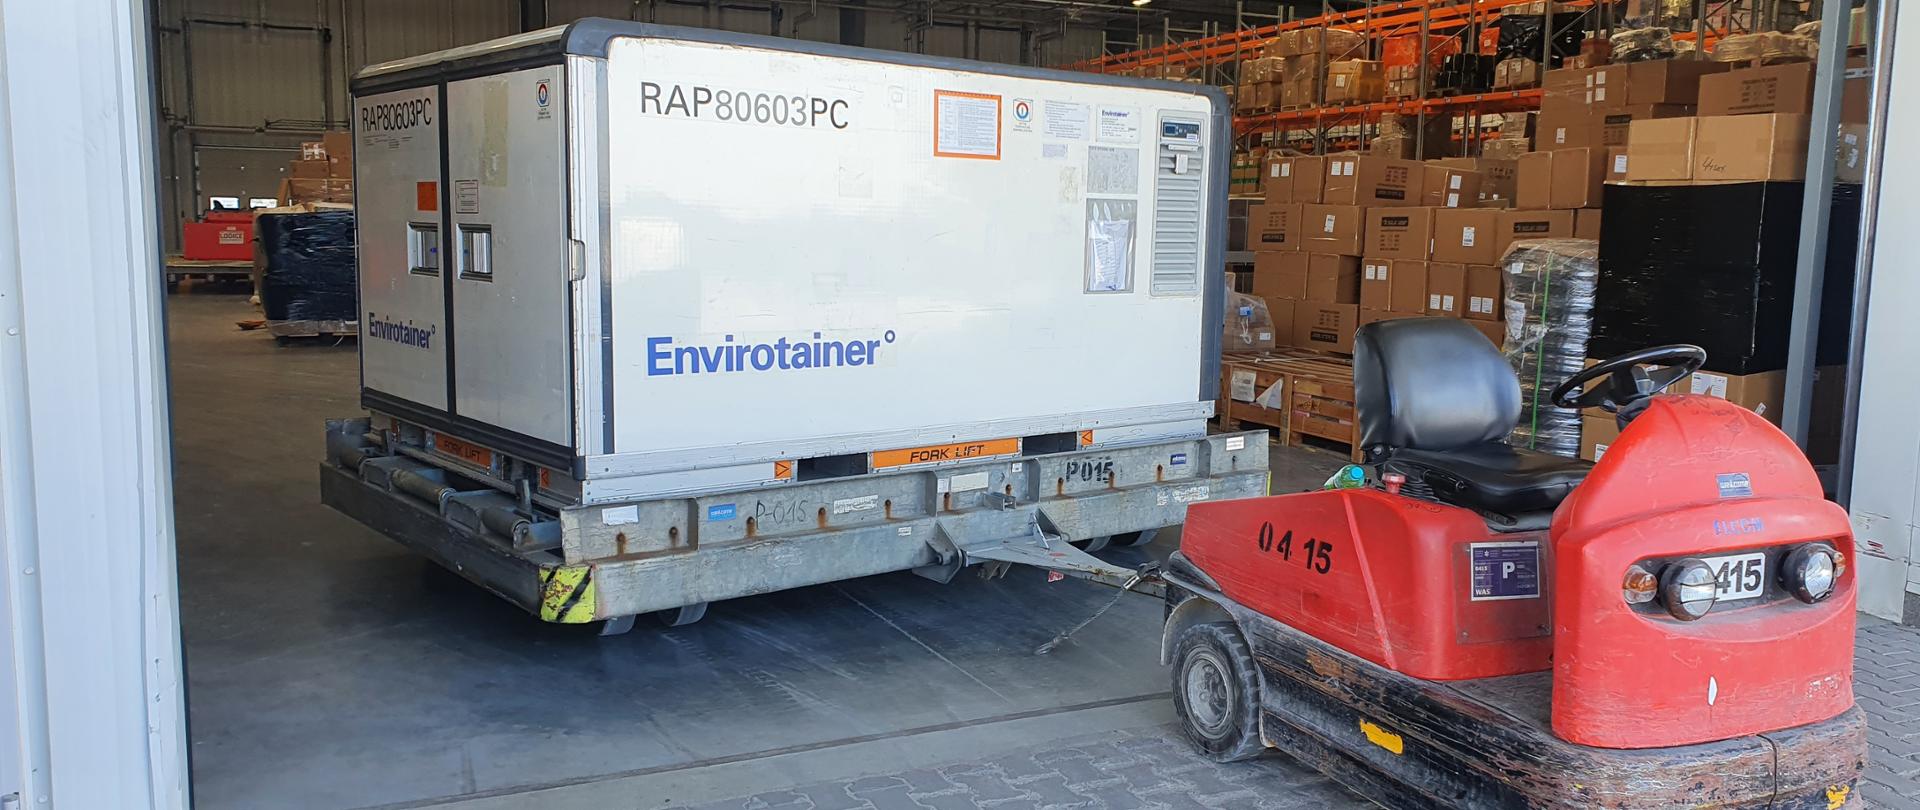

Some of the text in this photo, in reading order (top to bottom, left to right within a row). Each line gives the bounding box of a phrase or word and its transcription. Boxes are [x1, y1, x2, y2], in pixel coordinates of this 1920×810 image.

[362, 97, 433, 132] RAP80603PC
[641, 81, 849, 130] RAP80603PC
[909, 444, 985, 462] FORK LIFT
[755, 498, 808, 530] P-015
[1502, 561, 1516, 579] P
[1715, 558, 1762, 594] 415
[1474, 588, 1491, 596] WAS
